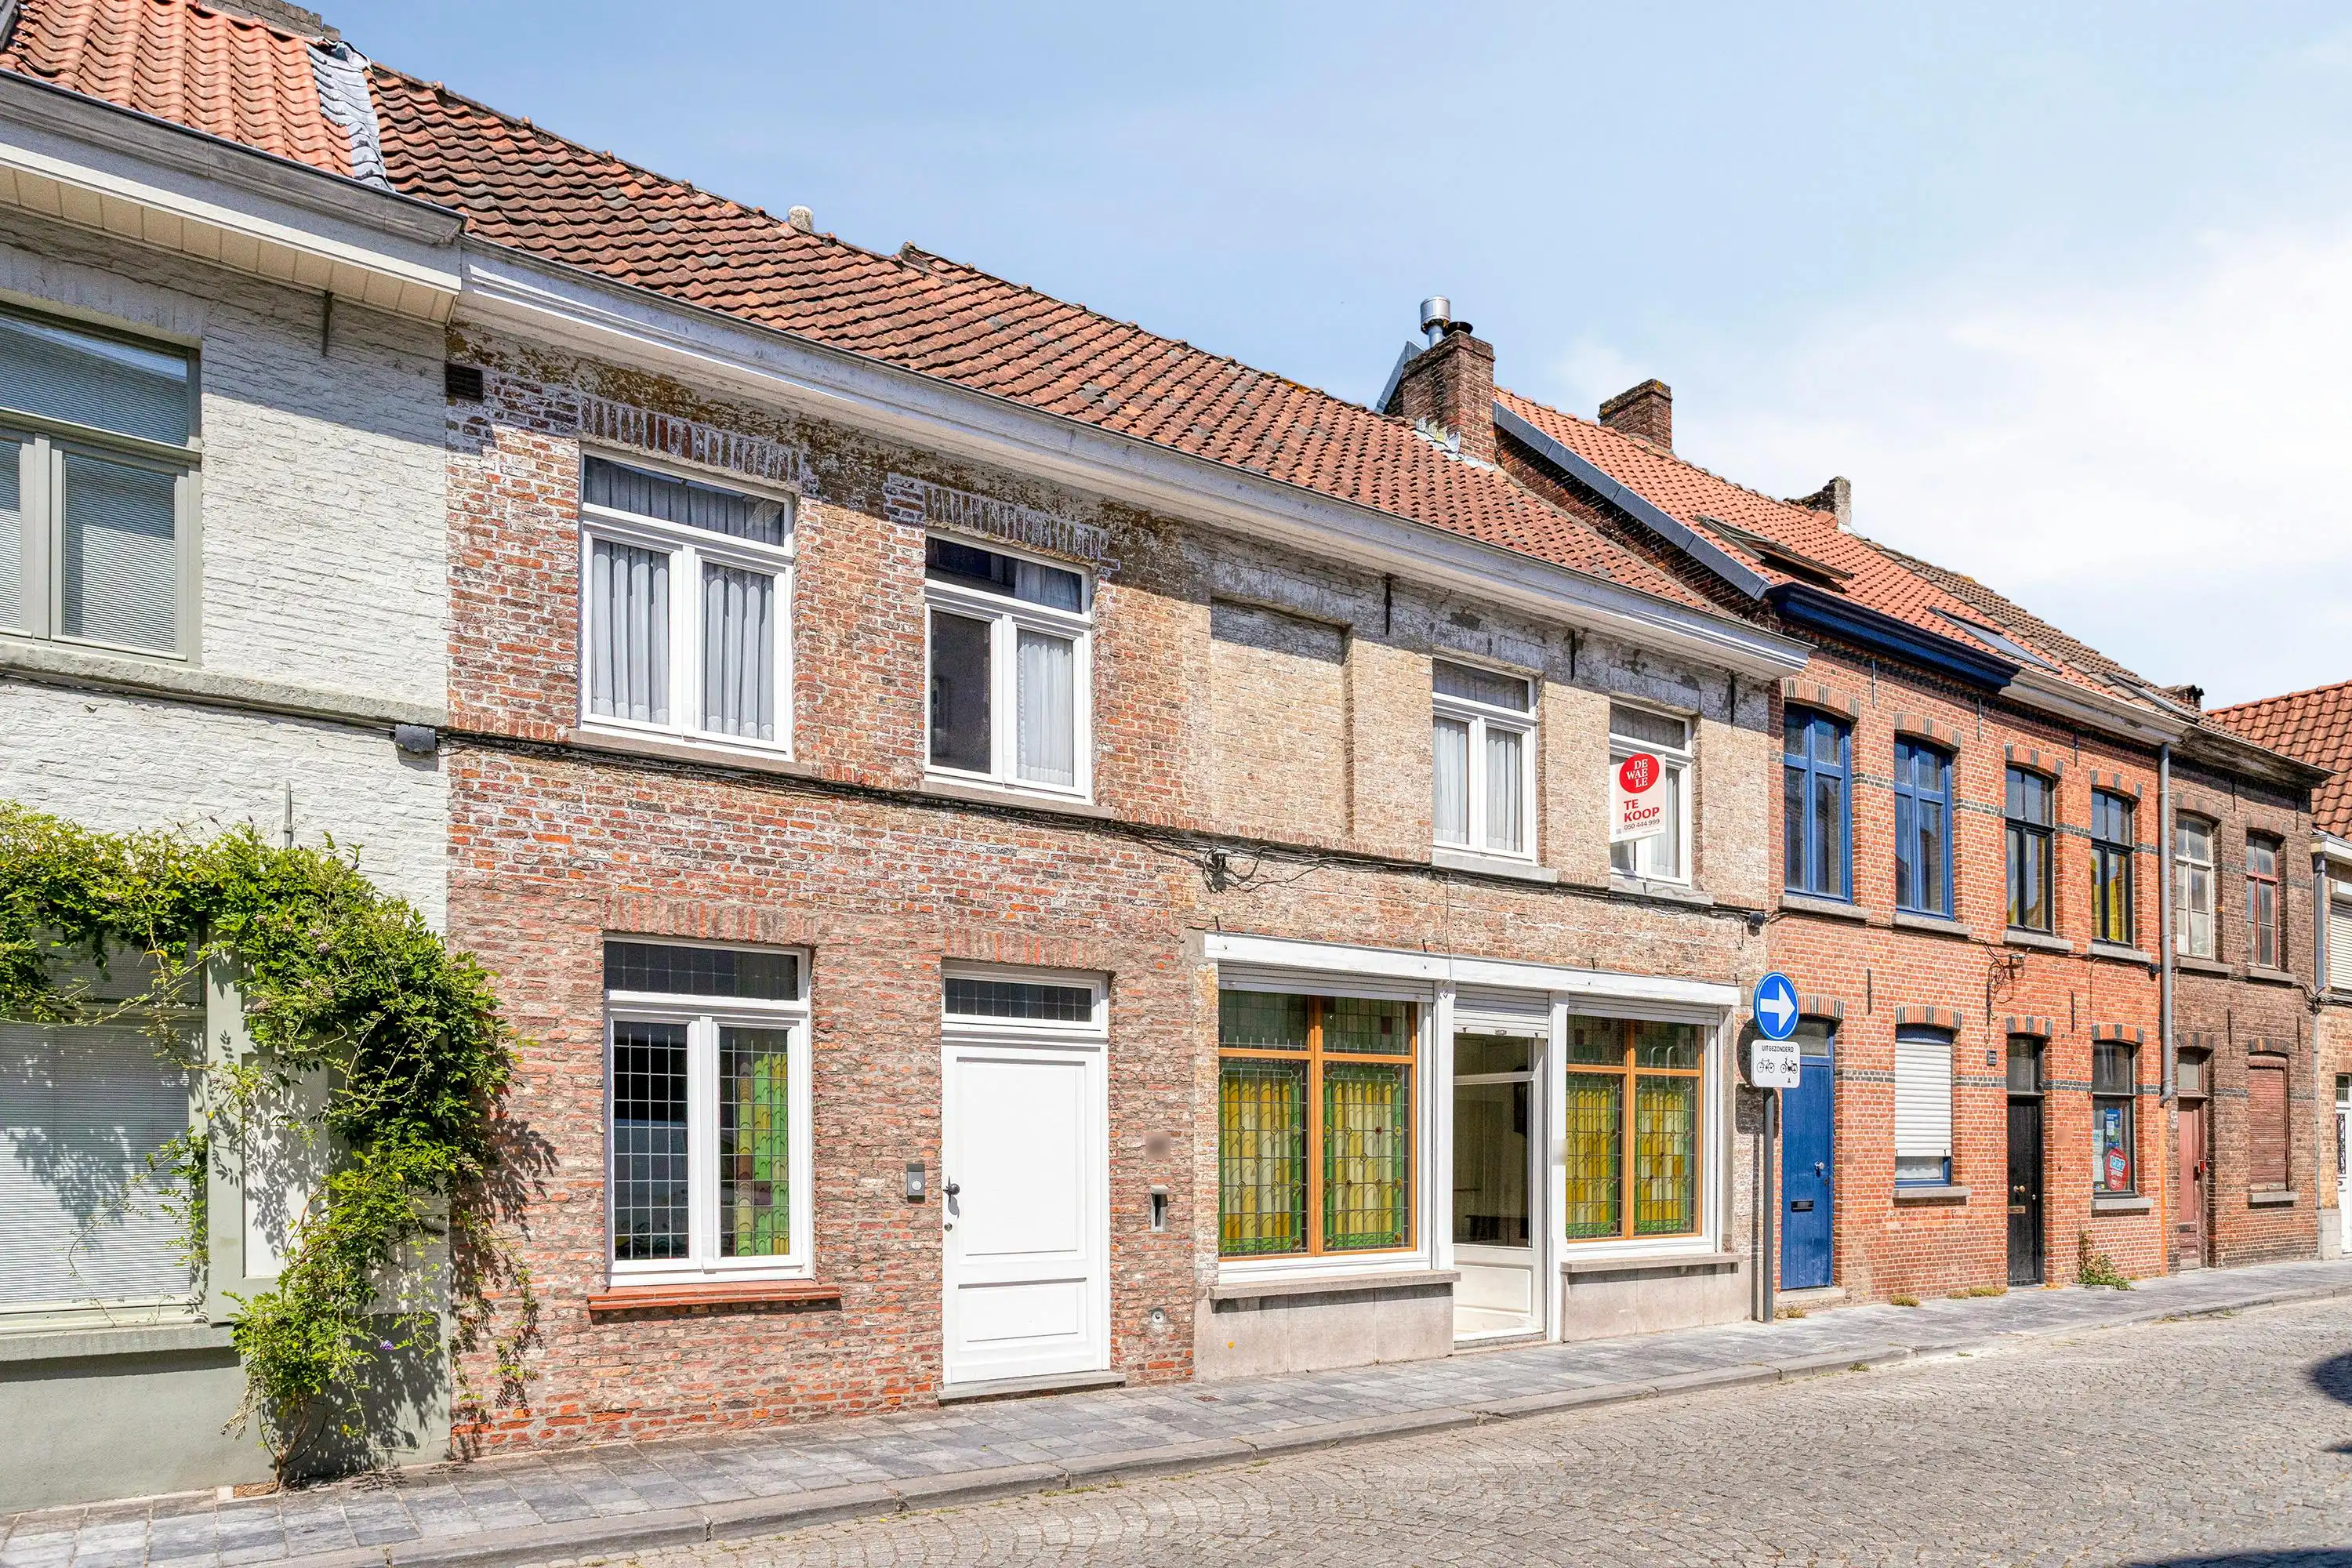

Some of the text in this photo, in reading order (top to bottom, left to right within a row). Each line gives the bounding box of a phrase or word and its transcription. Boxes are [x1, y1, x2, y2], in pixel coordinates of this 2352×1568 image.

[1635, 759, 1648, 769] DE
[1627, 768, 1648, 780] WAE
[1635, 778, 1648, 788] LE
[1624, 799, 1639, 810] TE
[1624, 807, 1660, 822] KOOP
